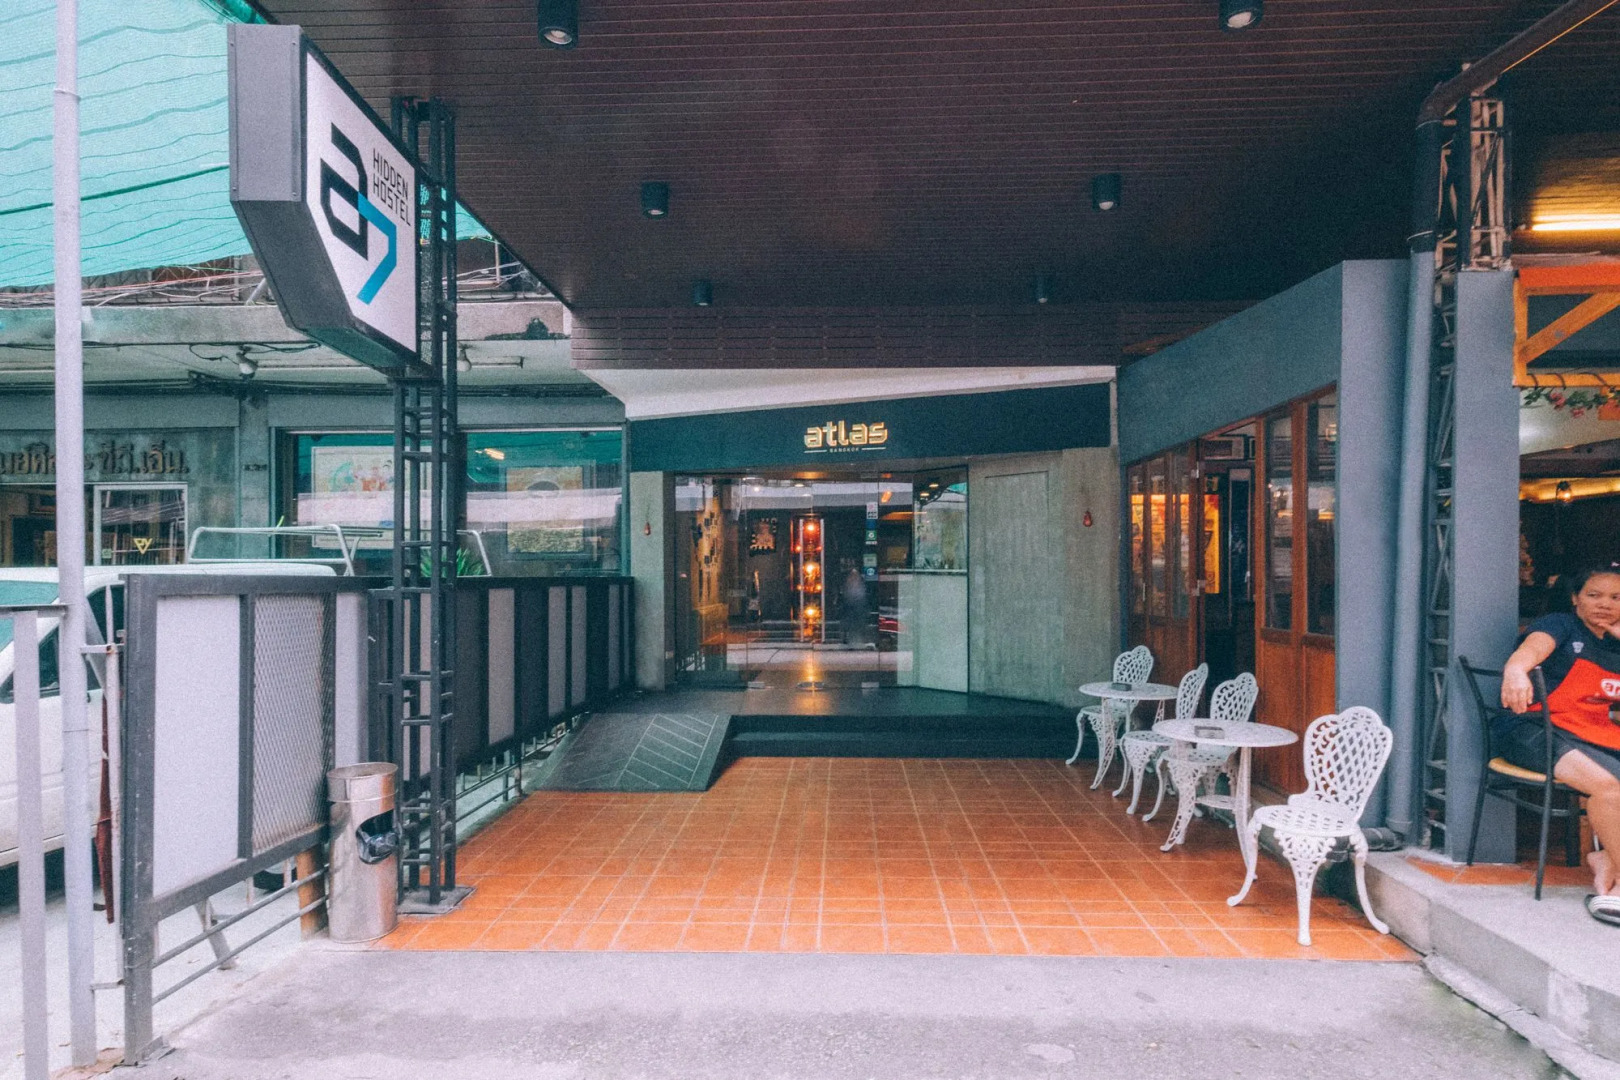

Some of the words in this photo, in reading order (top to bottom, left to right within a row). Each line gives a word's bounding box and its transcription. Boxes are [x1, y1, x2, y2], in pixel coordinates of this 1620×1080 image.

[372, 147, 409, 198] HIDDEN
[372, 172, 411, 227] HOSTEL
[803, 419, 888, 448] atlas
